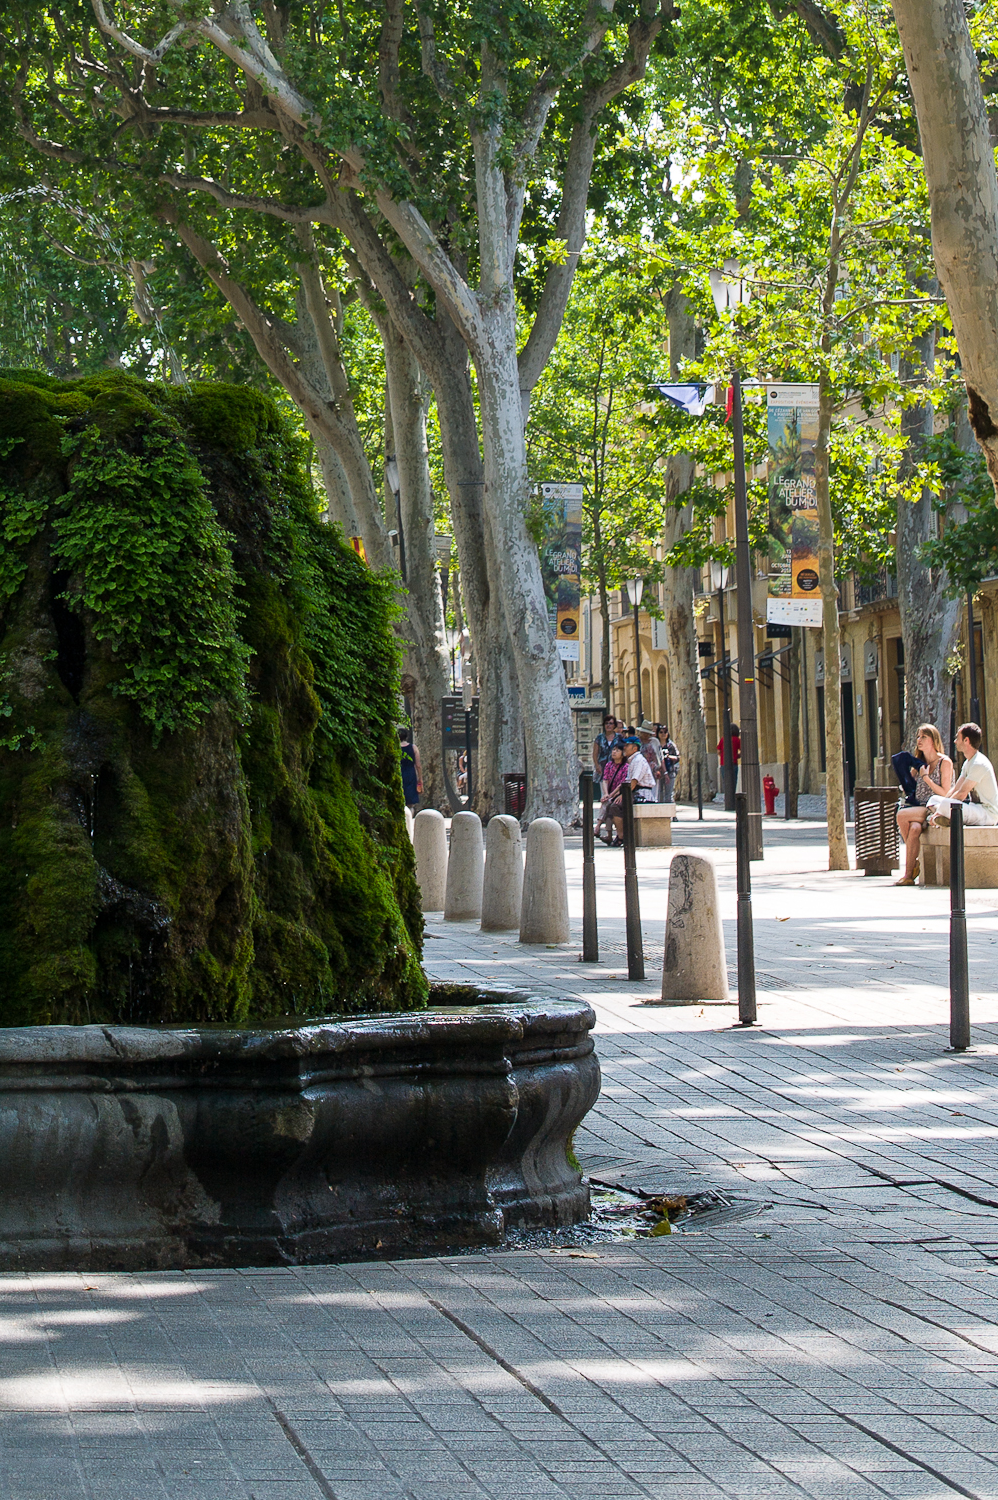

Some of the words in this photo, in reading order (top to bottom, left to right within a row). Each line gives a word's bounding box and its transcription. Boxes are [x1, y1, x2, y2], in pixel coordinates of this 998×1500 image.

[774, 476, 784, 484] LE
[784, 476, 816, 488] GRAND
[779, 488, 813, 498] ATELIER
[786, 496, 798, 506] DU
[799, 496, 817, 509] MIDI
[553, 549, 576, 558] GRAND
[554, 564, 563, 572] DU
[564, 565, 577, 574] MIDI
